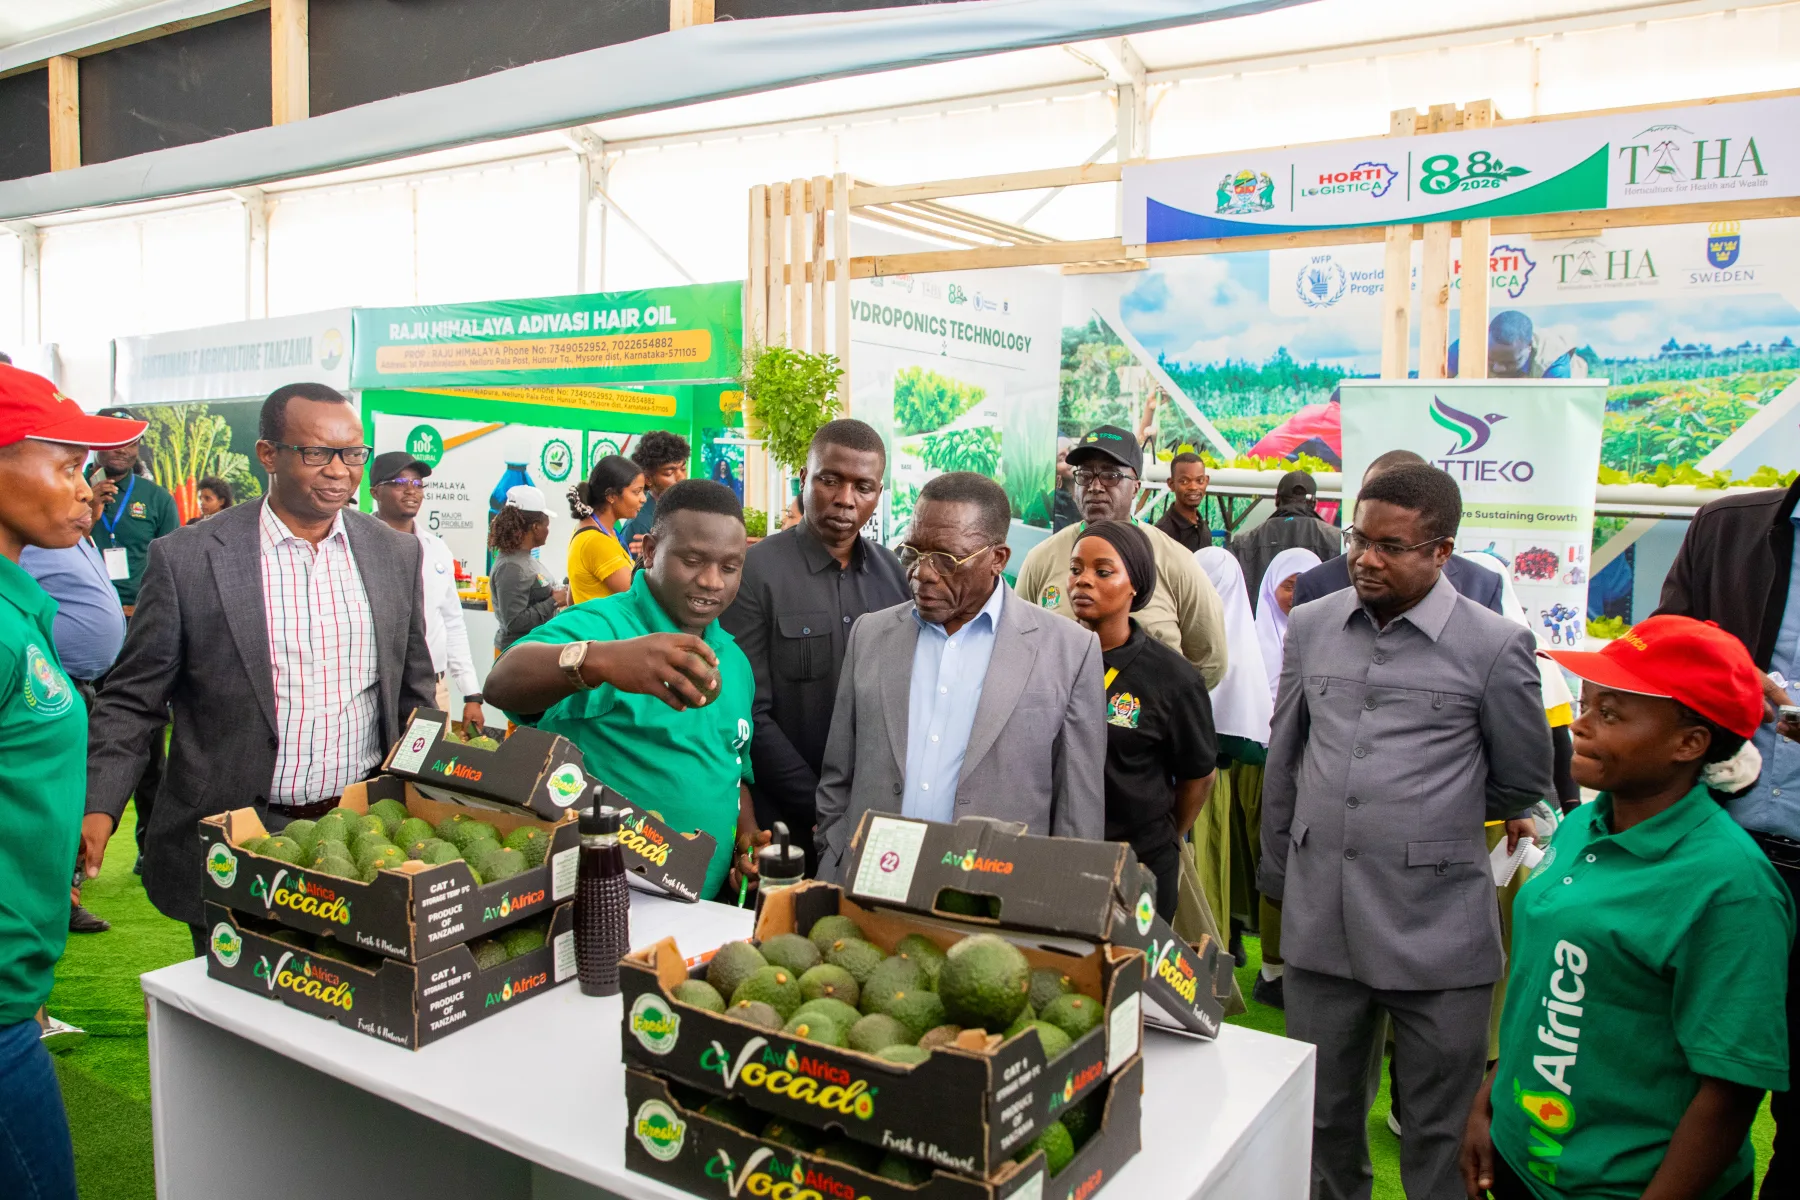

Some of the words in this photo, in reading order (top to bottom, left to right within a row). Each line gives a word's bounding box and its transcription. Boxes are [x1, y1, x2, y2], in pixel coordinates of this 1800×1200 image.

[1619, 136, 1768, 186] TAHA
[1318, 168, 1381, 185] HORTI
[1460, 178, 1501, 192] 2026
[1301, 181, 1383, 197] LOGISTICA
[1624, 186, 1673, 196] Horticulture
[1676, 184, 1689, 192] for
[1690, 182, 1718, 191] Health
[1720, 180, 1736, 189] and
[1739, 178, 1769, 188] Wealth
[1311, 255, 1332, 264] WFP
[1552, 248, 1659, 284] TAHA
[1350, 269, 1384, 281] World
[1690, 270, 1755, 284] SWEDEN
[389, 322, 428, 340] RAJU
[430, 316, 515, 338] HIMALAYA
[518, 311, 590, 333] ADIVASI
[593, 307, 640, 330] HAIR
[643, 305, 677, 325] OIL
[850, 298, 947, 337] YDROPONICS
[949, 319, 1032, 353] TECHNOLOGY
[263, 336, 313, 369] TANZANIA
[432, 348, 453, 358] RAJU
[456, 347, 501, 357] HIMALAYA
[503, 344, 529, 356] Phone
[532, 344, 547, 355] No:
[549, 341, 609, 354] 7349052952,
[612, 337, 673, 350] 7022654882
[513, 356, 530, 365] Post,
[532, 355, 558, 364] Hunsur
[575, 353, 602, 363] Mysore
[605, 352, 622, 362] dist,
[624, 347, 697, 360] Karnataka-571105
[412, 453, 437, 462] NATURAL
[1429, 460, 1534, 482] TTIEKO
[436, 493, 455, 501] HAIR
[457, 493, 471, 501] OIL
[429, 510, 440, 530] 5
[441, 520, 473, 528] PROBLEMS
[1475, 510, 1534, 523] Sustaining
[1536, 511, 1578, 522] Growth
[413, 738, 424, 751] 22
[881, 852, 898, 871] 22
[430, 880, 449, 894] CAT
[449, 878, 456, 887] 1
[428, 904, 463, 922] PRODUCE
[441, 916, 452, 928] OF
[428, 922, 465, 943] TANZANIA
[356, 931, 375, 947] Fresh
[381, 939, 408, 957] Natural
[431, 969, 450, 982] CAT
[450, 965, 457, 975] 1
[429, 991, 465, 1012] PRODUCE
[443, 1004, 453, 1016] OF
[430, 1009, 467, 1031] TANZANIA
[357, 1018, 377, 1035] Fresh
[383, 1025, 409, 1045] Natural
[882, 1129, 913, 1153] Fresh
[927, 1143, 975, 1171] Natural
